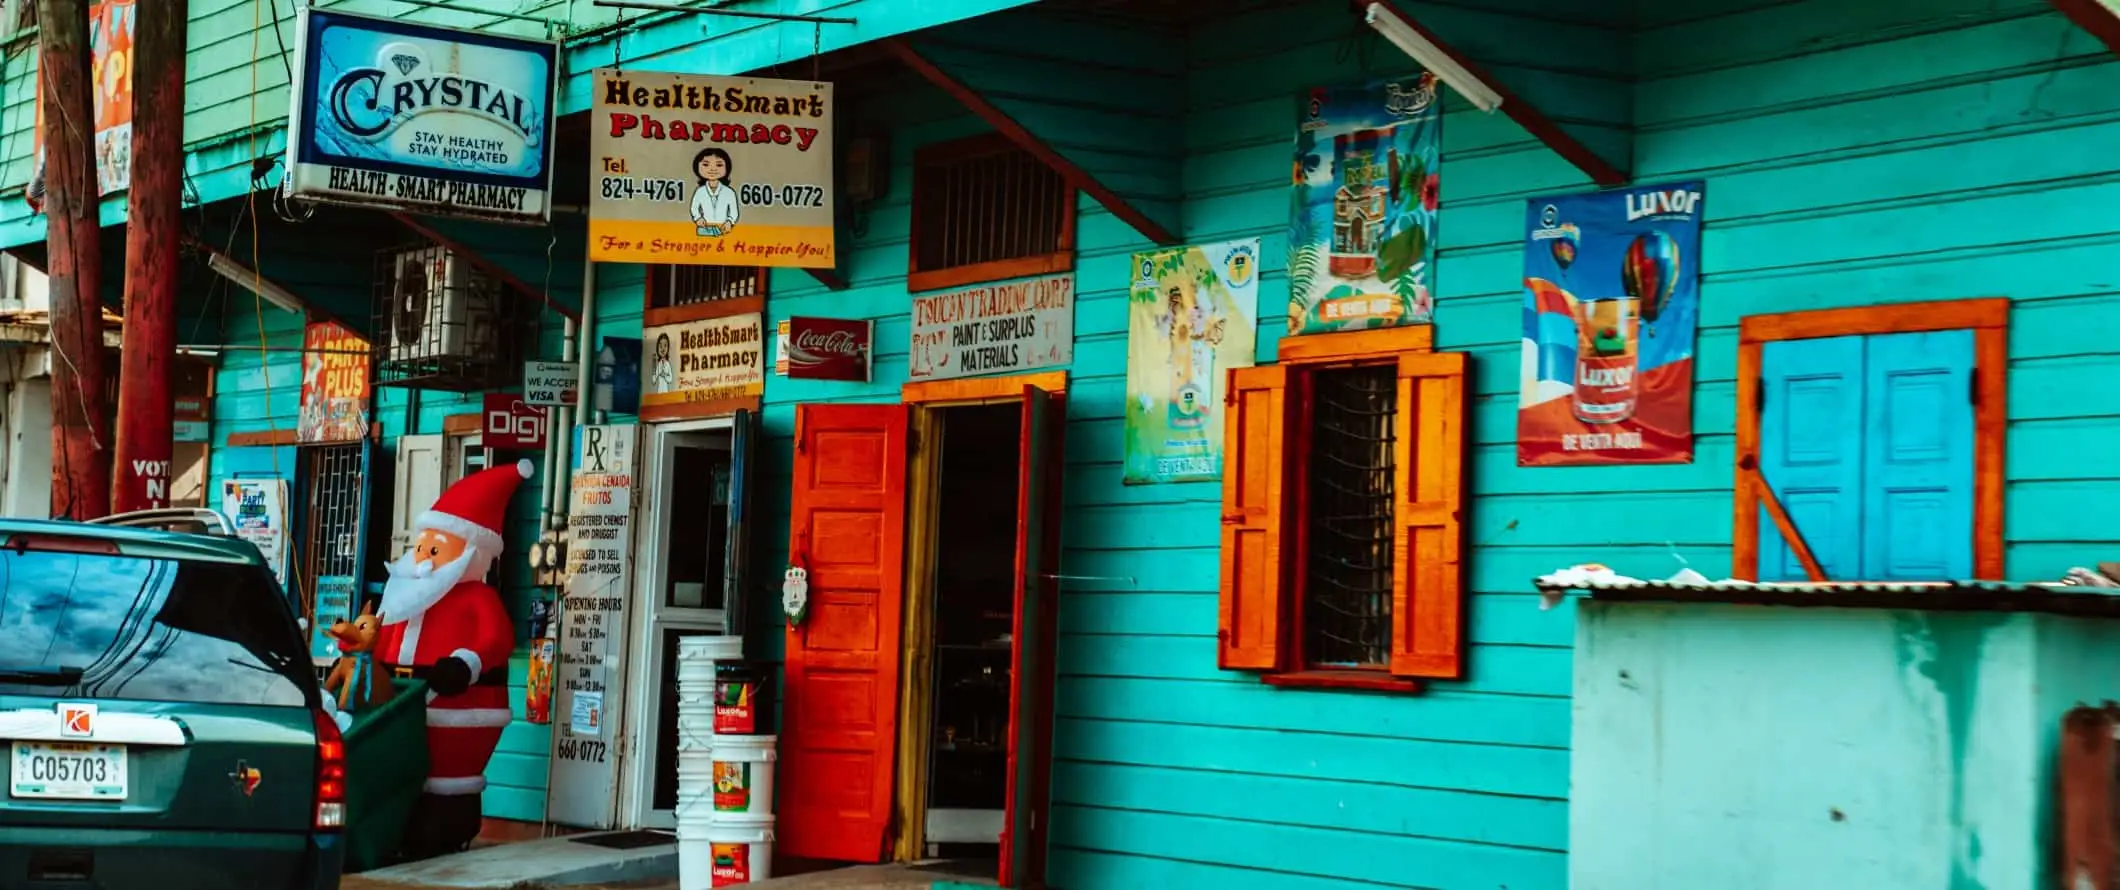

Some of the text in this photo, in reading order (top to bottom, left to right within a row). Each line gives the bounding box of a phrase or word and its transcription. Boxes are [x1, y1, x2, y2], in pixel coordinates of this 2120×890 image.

[330, 68, 530, 137] CRYSTAL
[605, 79, 824, 117] HealthSmart
[415, 131, 504, 151] STAY HEALTHY
[609, 112, 818, 151] Pharmacy
[409, 143, 508, 164] STAY HYDRATED
[449, 181, 526, 211] PHARMACY
[601, 177, 824, 207] 824-4761 660-0772
[600, 236, 631, 251] For
[679, 322, 759, 351] HealthSmart
[953, 323, 981, 347] PAINT
[988, 315, 1035, 342] SURPLUS
[679, 349, 759, 373] Pharmacy
[961, 344, 1019, 372] MATERIALS
[325, 366, 363, 399] PLUS
[528, 377, 541, 386] WE
[529, 391, 554, 401] VISA
[607, 549, 619, 560] SELL
[564, 598, 622, 611] OPENING HOURS
[581, 641, 592, 653] SAT
[558, 739, 606, 763] 660-0772
